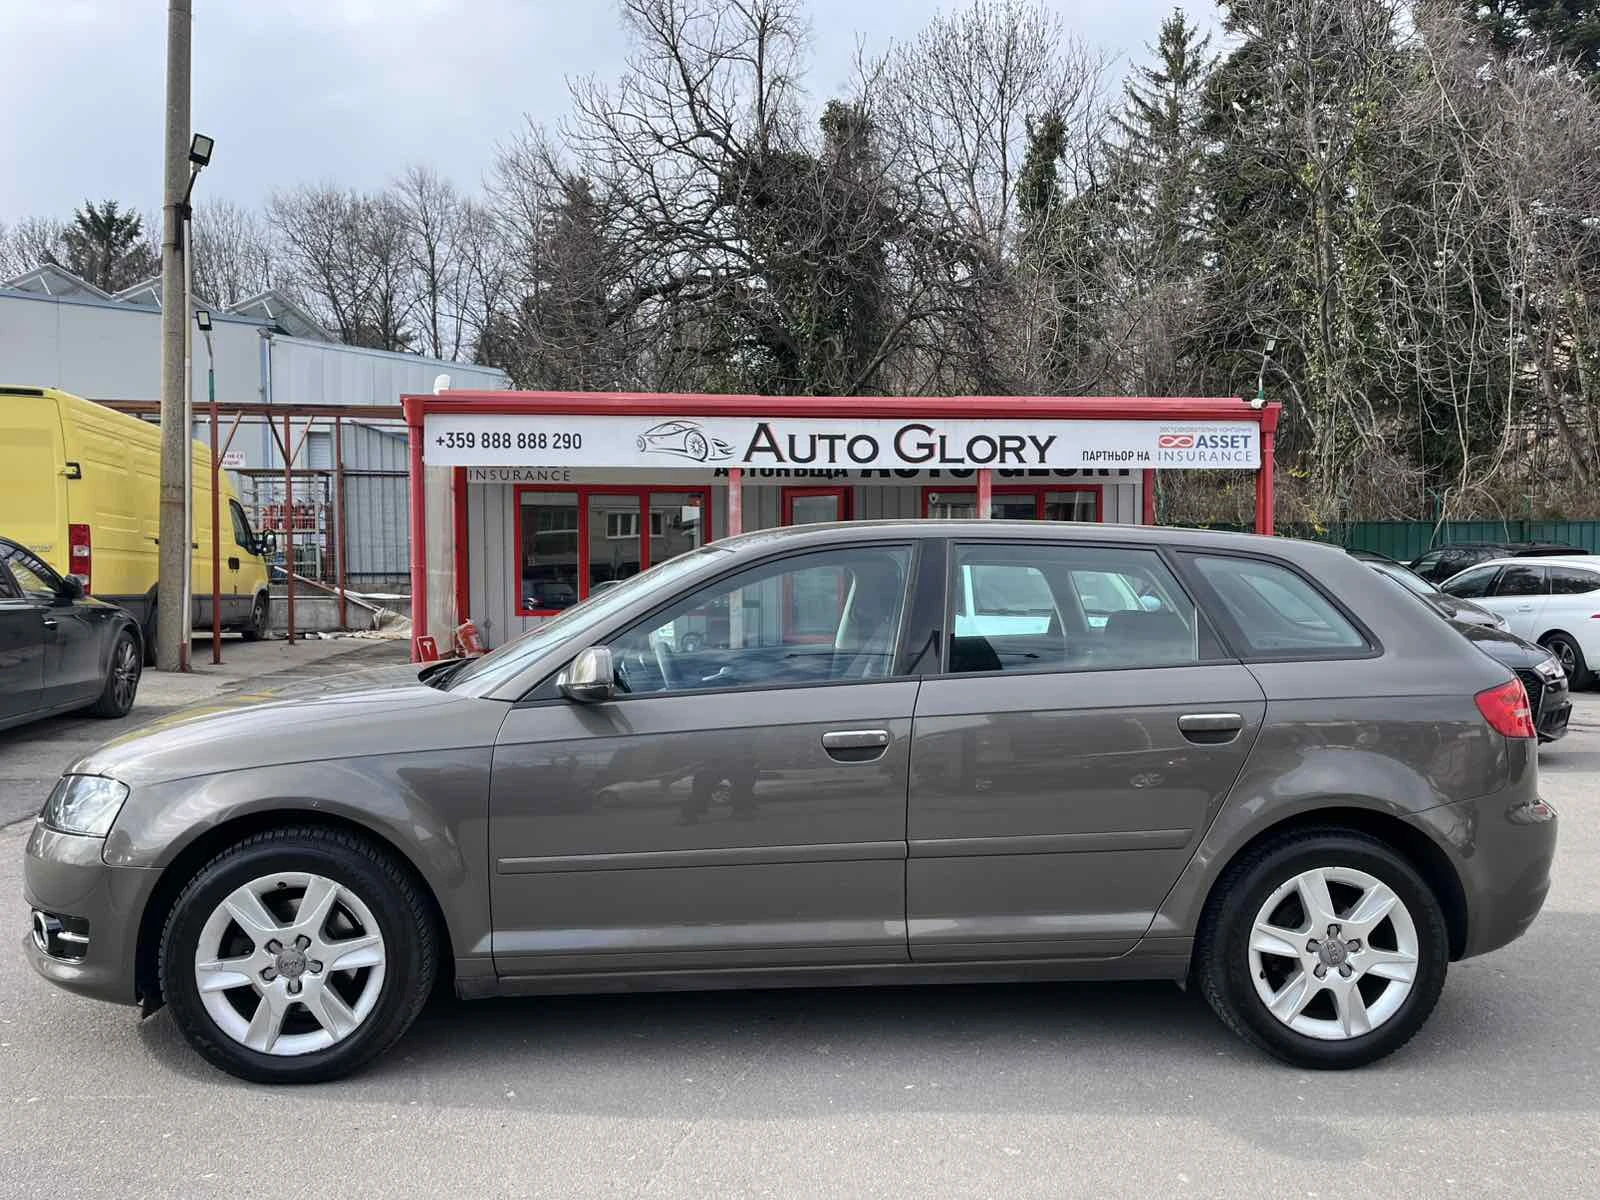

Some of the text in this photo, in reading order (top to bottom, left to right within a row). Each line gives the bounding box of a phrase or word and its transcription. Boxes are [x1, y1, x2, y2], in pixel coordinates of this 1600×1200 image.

[435, 432, 582, 449] +359 888 888 290
[742, 422, 1057, 464] AUTO GLORY
[1195, 435, 1251, 449] ASSET
[1082, 450, 1150, 461] ПАРТНЬОР НА
[1158, 451, 1253, 462] INSURANCE
[469, 470, 571, 481] INSURANCE
